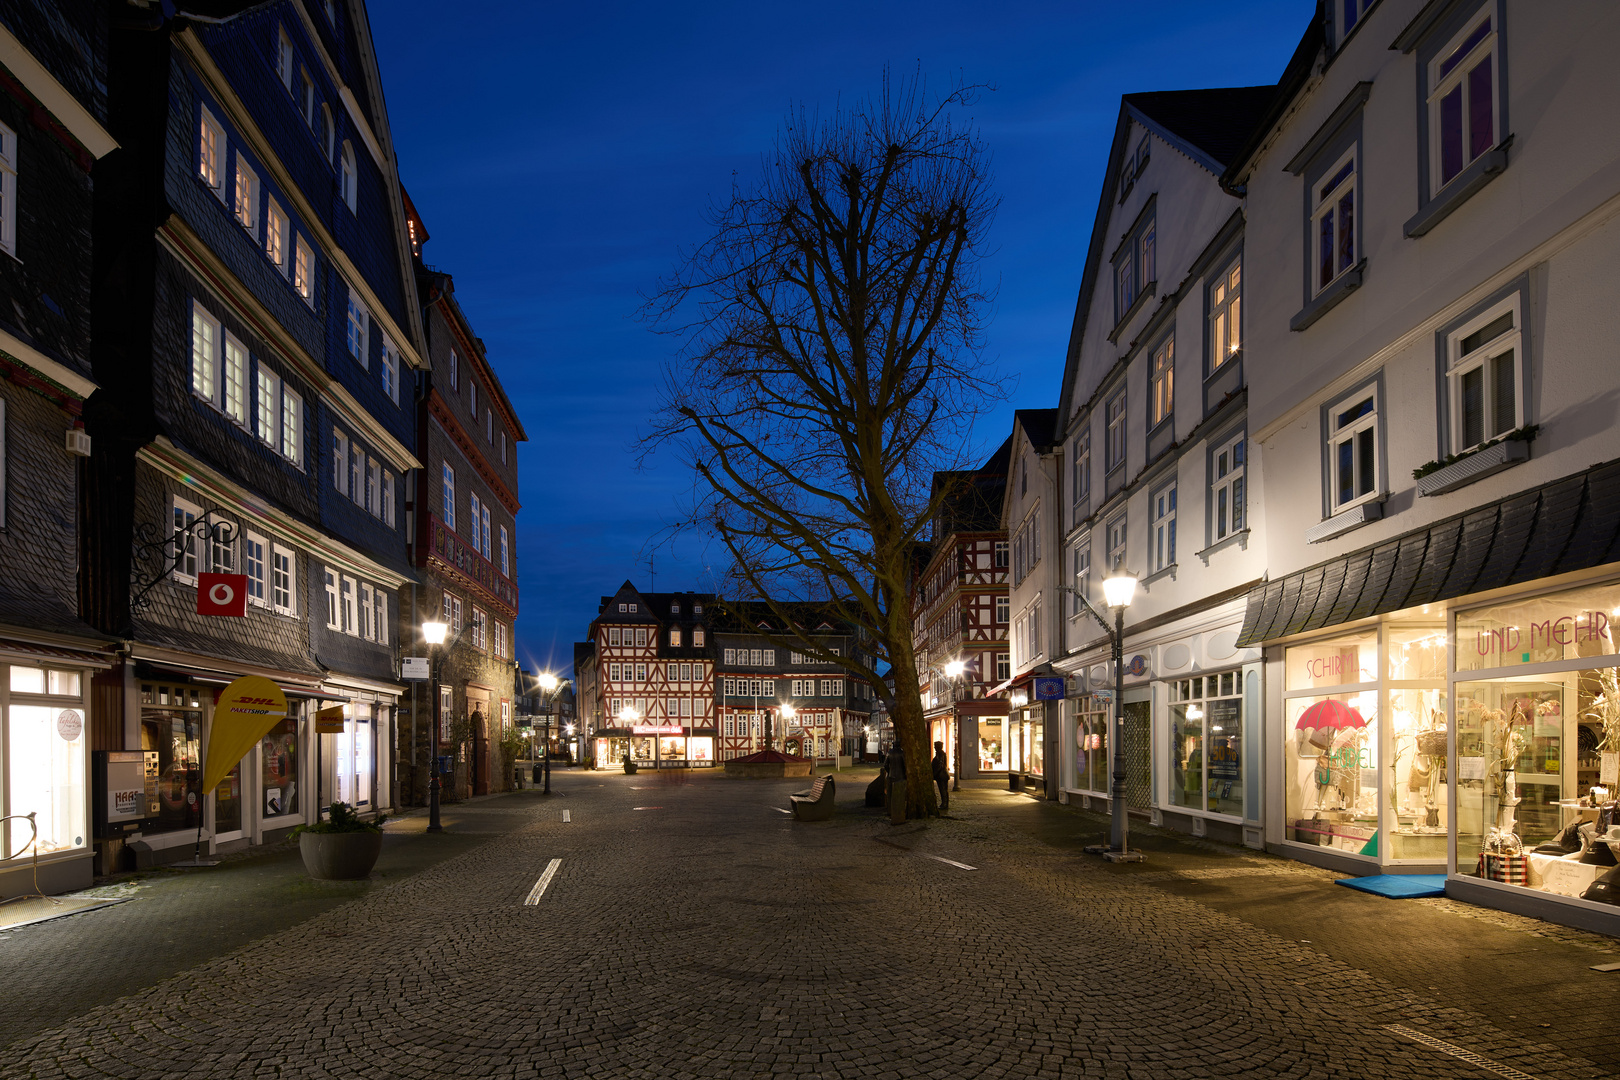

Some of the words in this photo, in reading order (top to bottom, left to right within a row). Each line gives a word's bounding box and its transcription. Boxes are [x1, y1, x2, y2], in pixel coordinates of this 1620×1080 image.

[1477, 626, 1520, 656] UND
[1531, 611, 1608, 649] MEHR
[237, 696, 277, 706] DHL
[230, 707, 269, 715] PAKETSHOP
